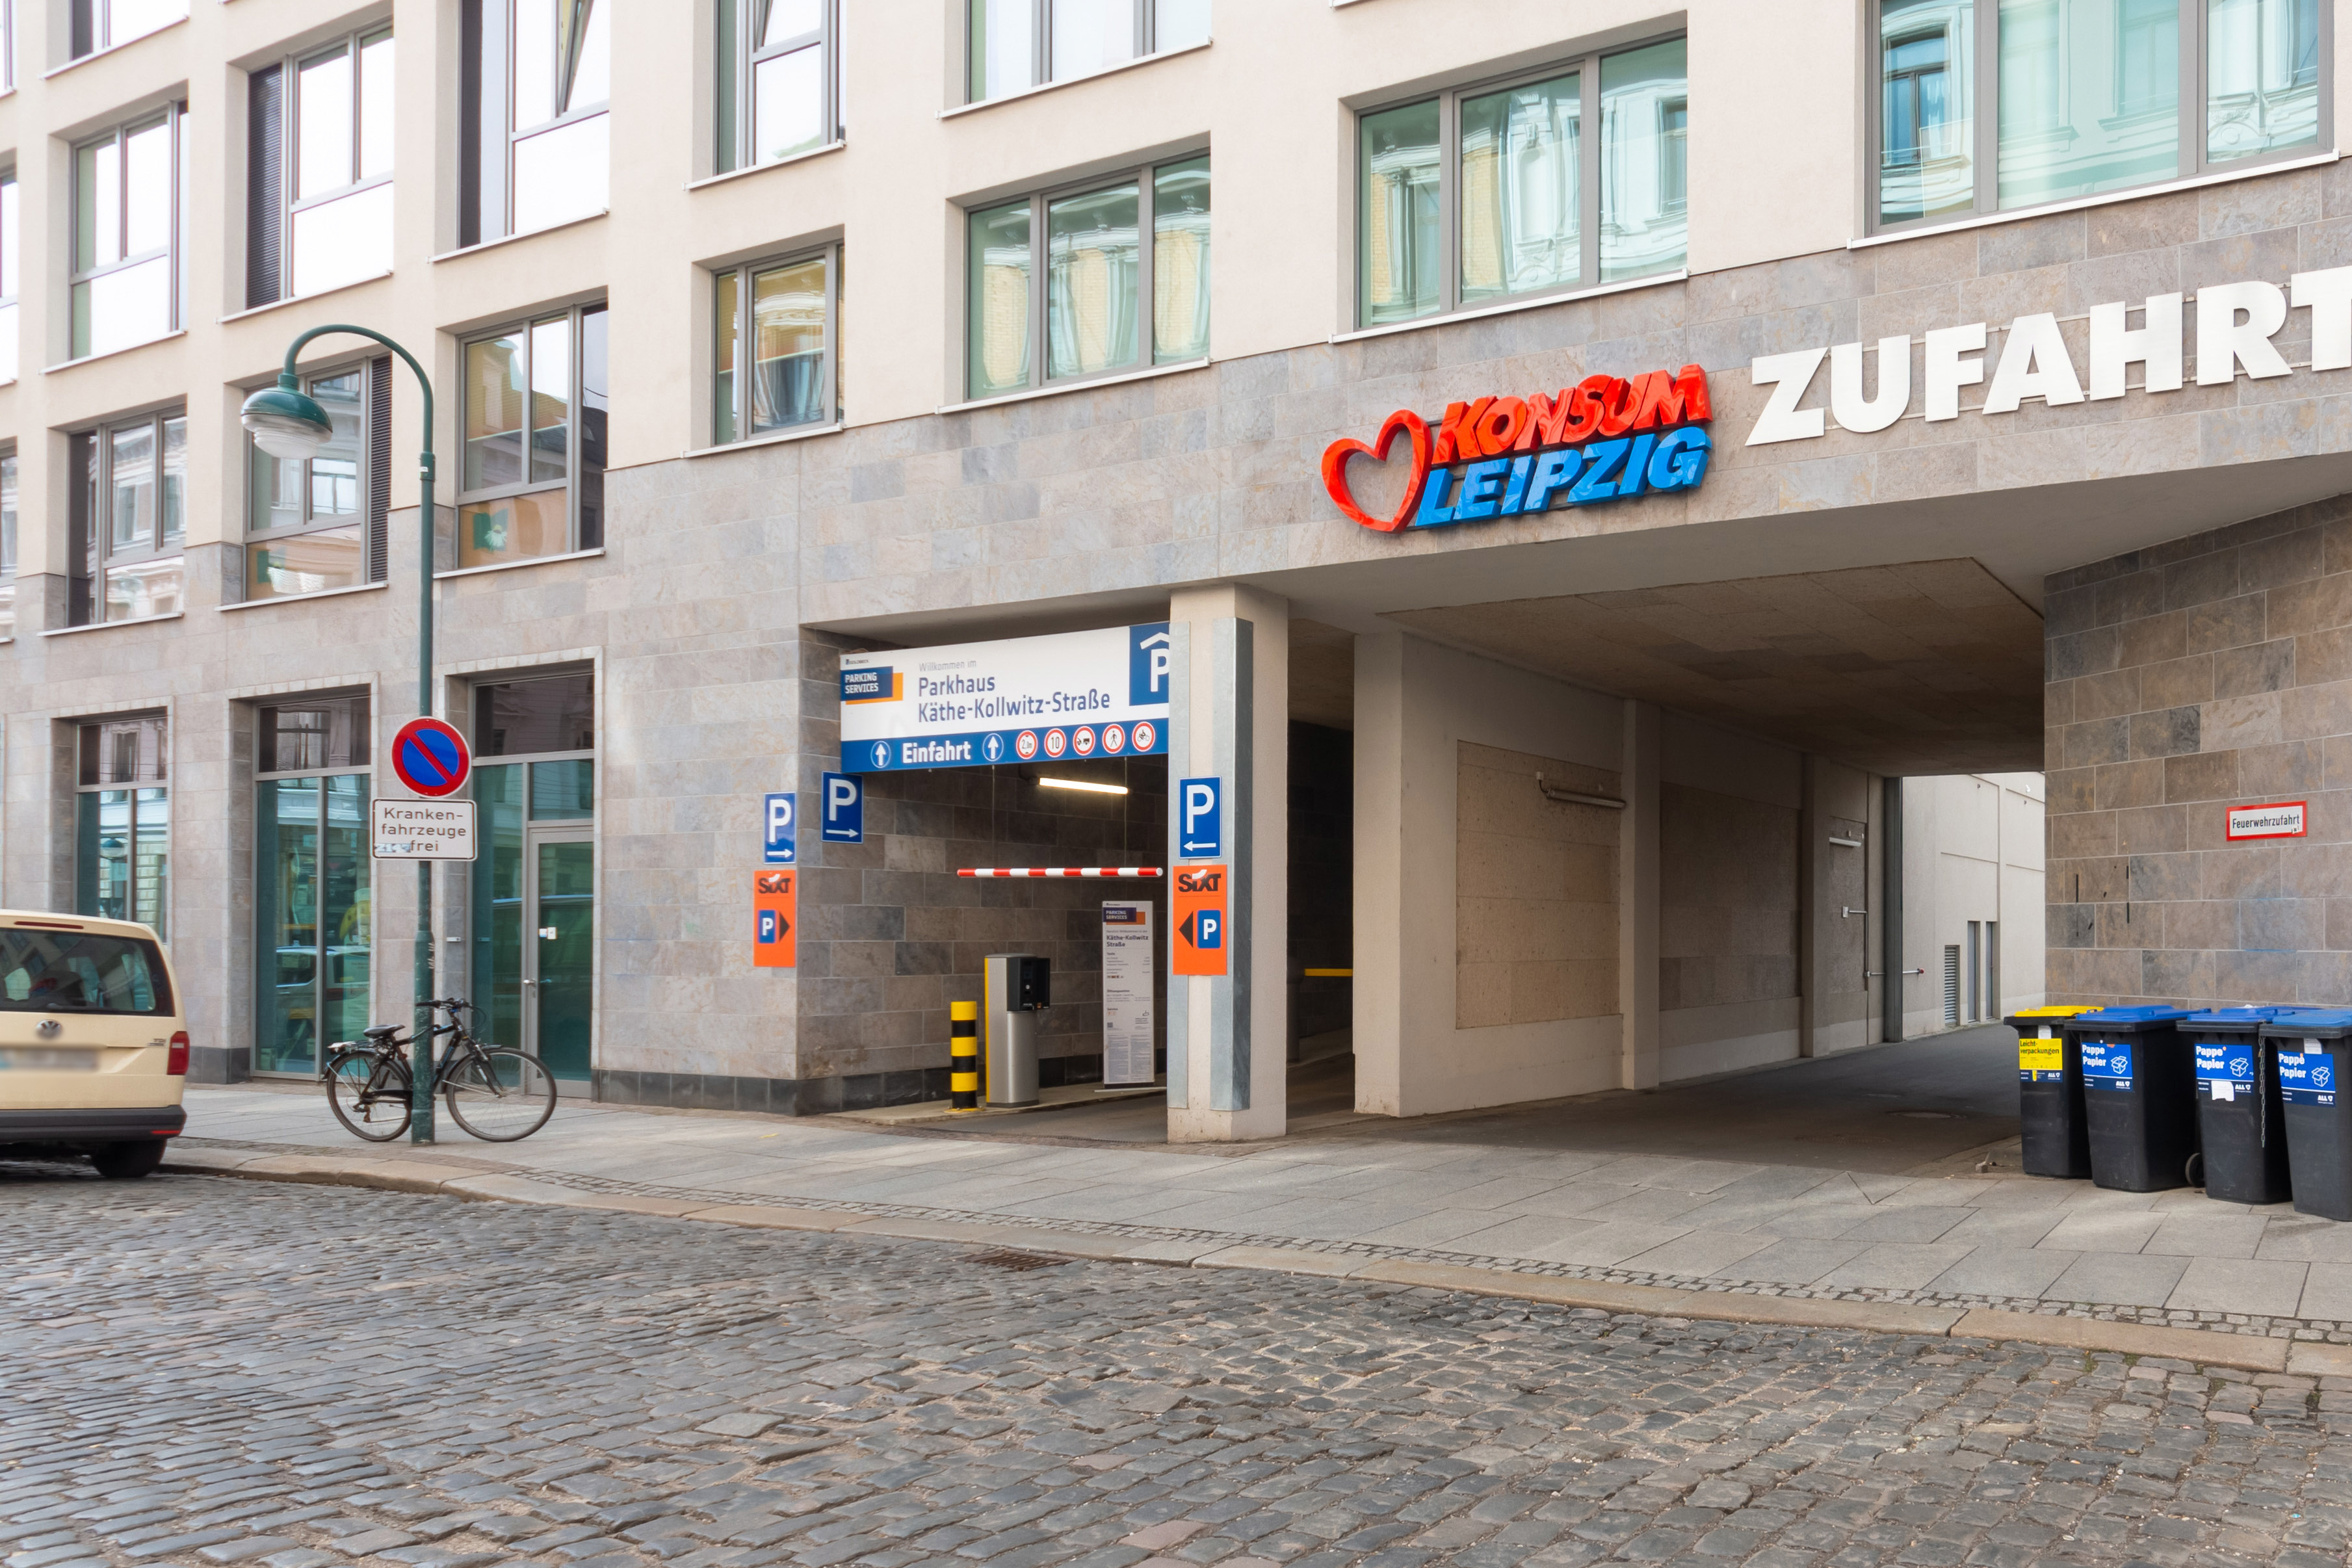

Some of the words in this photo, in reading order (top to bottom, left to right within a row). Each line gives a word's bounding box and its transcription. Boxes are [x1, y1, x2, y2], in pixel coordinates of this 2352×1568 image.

[1745, 266, 2352, 446] ZUFAHRT
[1431, 364, 1713, 467] KONSUM
[1415, 426, 1712, 529] LEIPZIG
[919, 661, 965, 672] Willkommen
[967, 659, 976, 668] im
[844, 672, 878, 683] PARKING
[844, 683, 879, 694] SERVICES
[919, 674, 995, 697] Parkhaus
[919, 688, 1110, 723] Käthe-Kollwitz-Straße
[1051, 737, 1060, 750] 10
[902, 740, 971, 764] Einfahrt
[829, 778, 857, 821] P
[384, 807, 464, 820] Kranken-
[1186, 784, 1215, 834] P
[768, 799, 792, 843] P
[2232, 814, 2300, 829] Feuerwehrzufahrt
[382, 823, 466, 839] fahrzeuge
[410, 840, 439, 852] frei
[762, 917, 774, 936] P
[1203, 919, 1217, 940] P
[2082, 1044, 2106, 1056] Pappe
[2195, 1045, 2223, 1058] Pappe
[2082, 1056, 2107, 1067] Papier
[2197, 1058, 2225, 1070] Papier
[2279, 1052, 2305, 1066] Pappe
[2280, 1066, 2306, 1079] Papier
